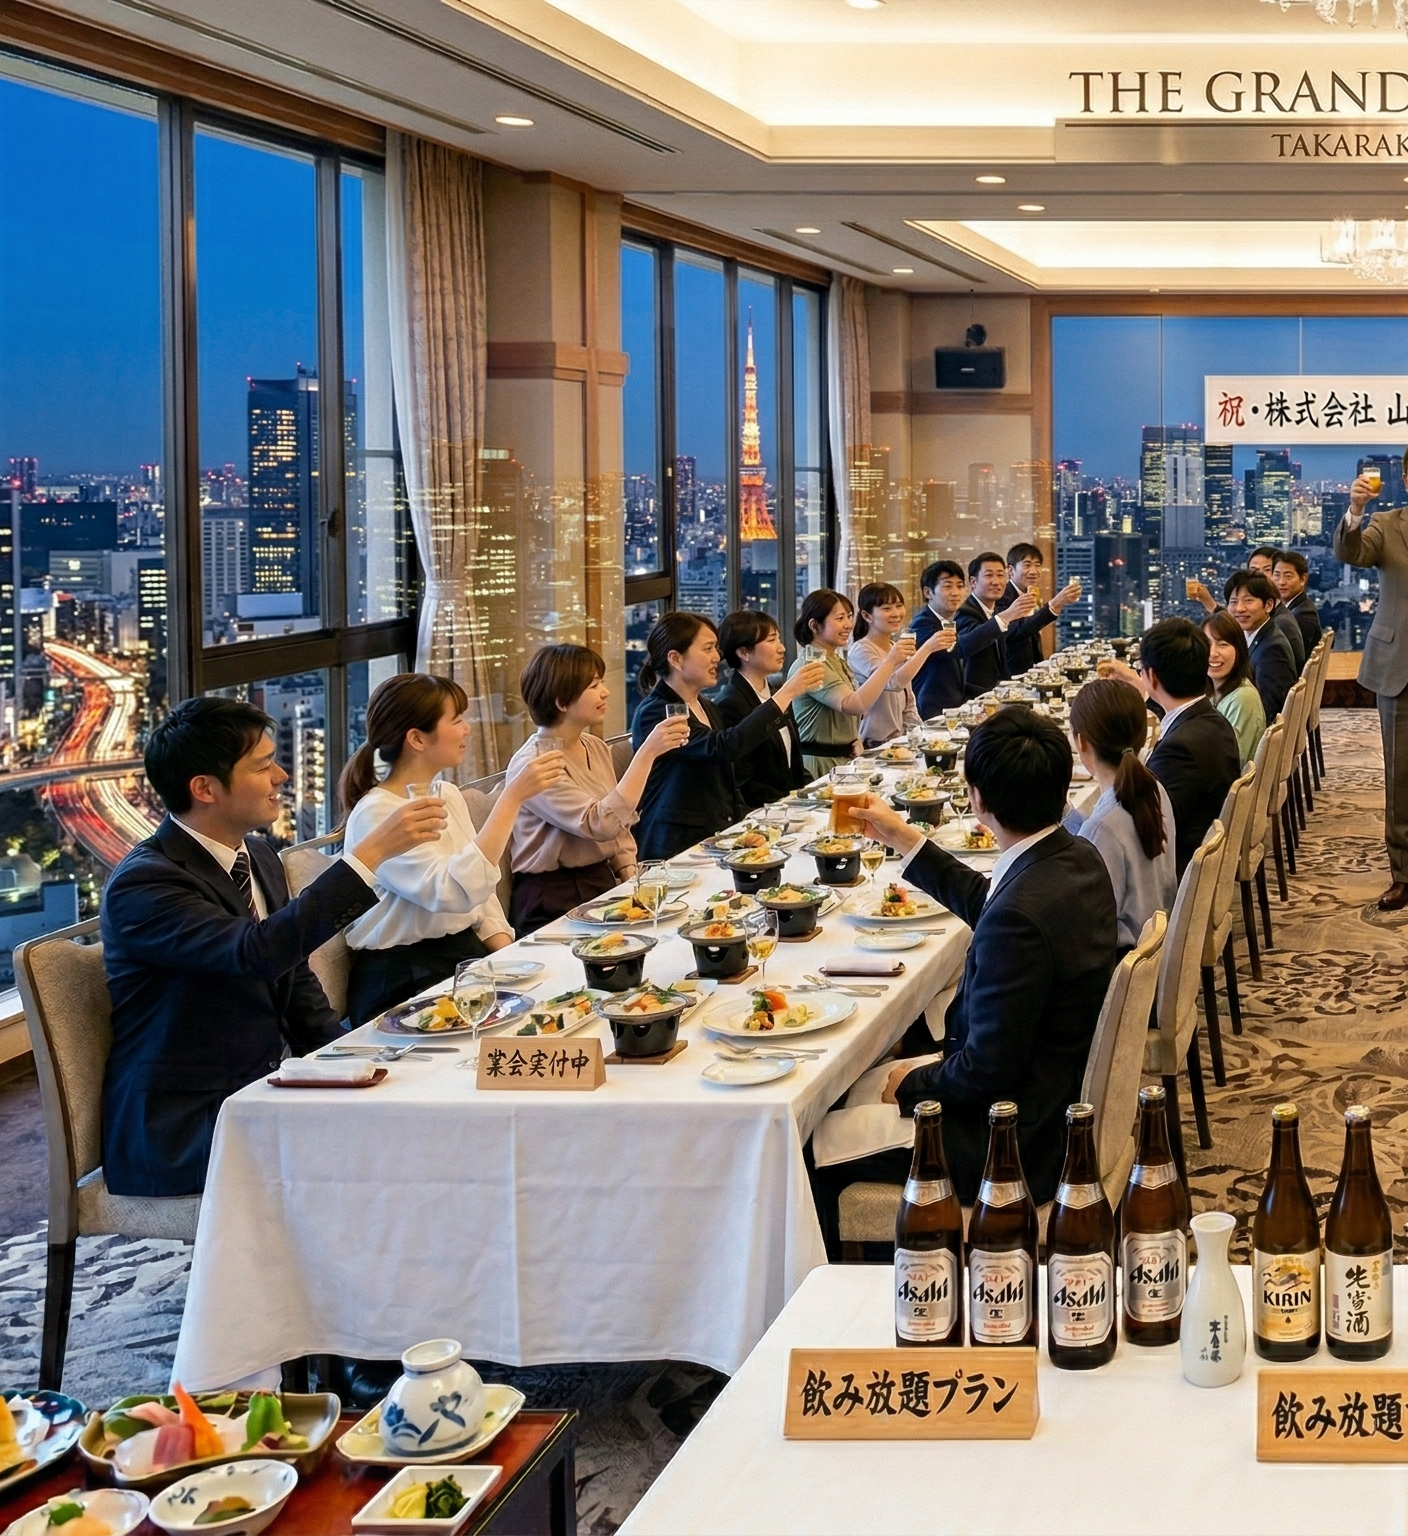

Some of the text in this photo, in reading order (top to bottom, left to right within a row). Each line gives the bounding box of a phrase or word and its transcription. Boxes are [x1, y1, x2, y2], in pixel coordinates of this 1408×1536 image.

[1068, 71, 1184, 113] THE
[1129, 1258, 1179, 1285] Asahi
[898, 1277, 948, 1303] Asahi
[973, 1279, 1024, 1305] Asahi
[1054, 1280, 1106, 1308] Asahi
[1263, 1289, 1312, 1307] KIRIN
[801, 1368, 1019, 1418] 飲み放題プラン
